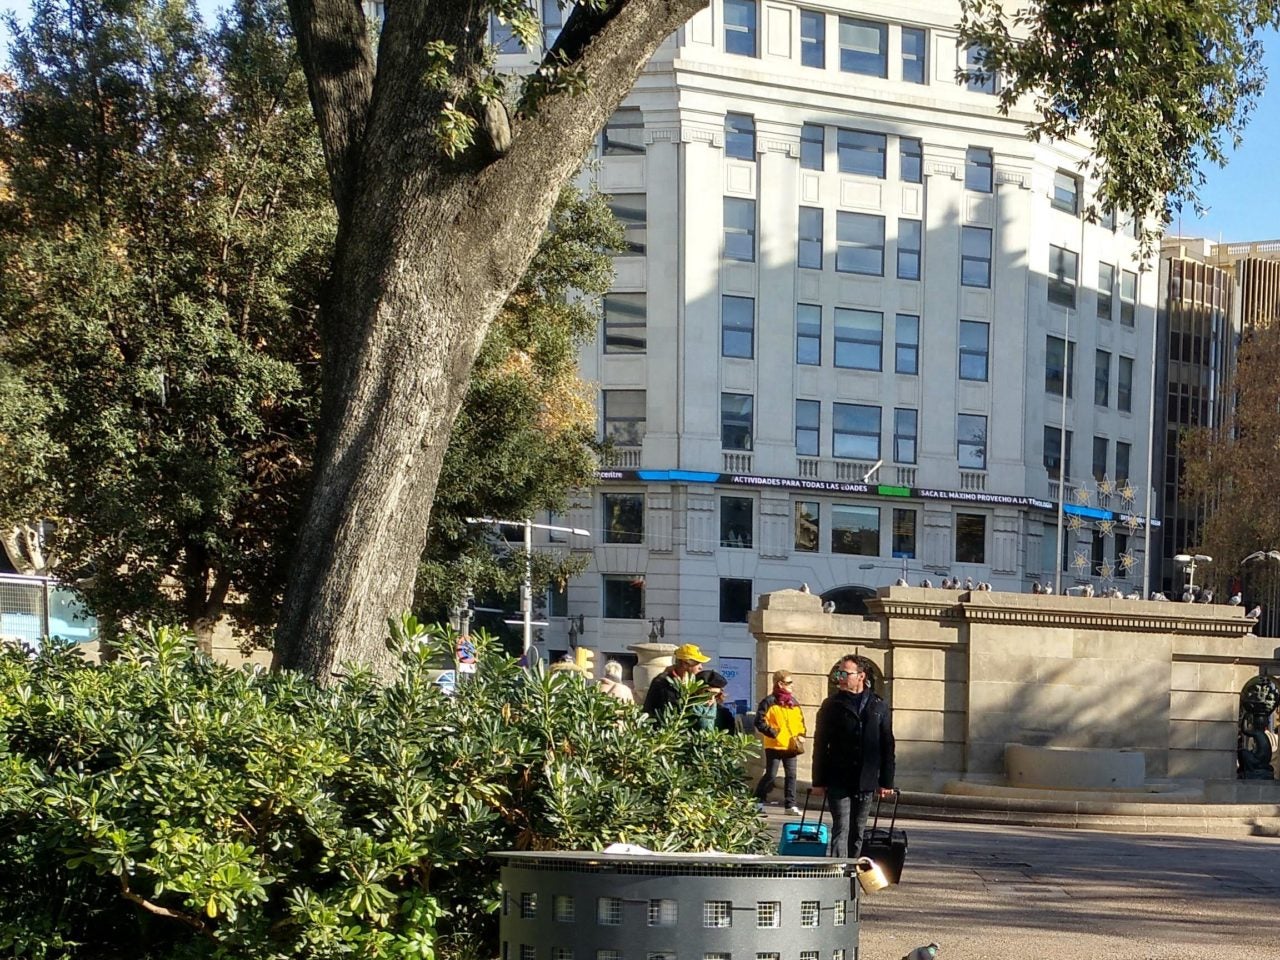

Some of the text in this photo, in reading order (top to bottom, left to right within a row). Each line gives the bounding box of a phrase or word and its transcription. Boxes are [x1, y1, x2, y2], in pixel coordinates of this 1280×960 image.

[734, 476, 780, 486] ACTIVIDADES
[782, 479, 800, 487] PARA
[802, 481, 825, 489] TODAS
[921, 490, 939, 498] SACA
[977, 495, 1011, 503] PROVECHO
